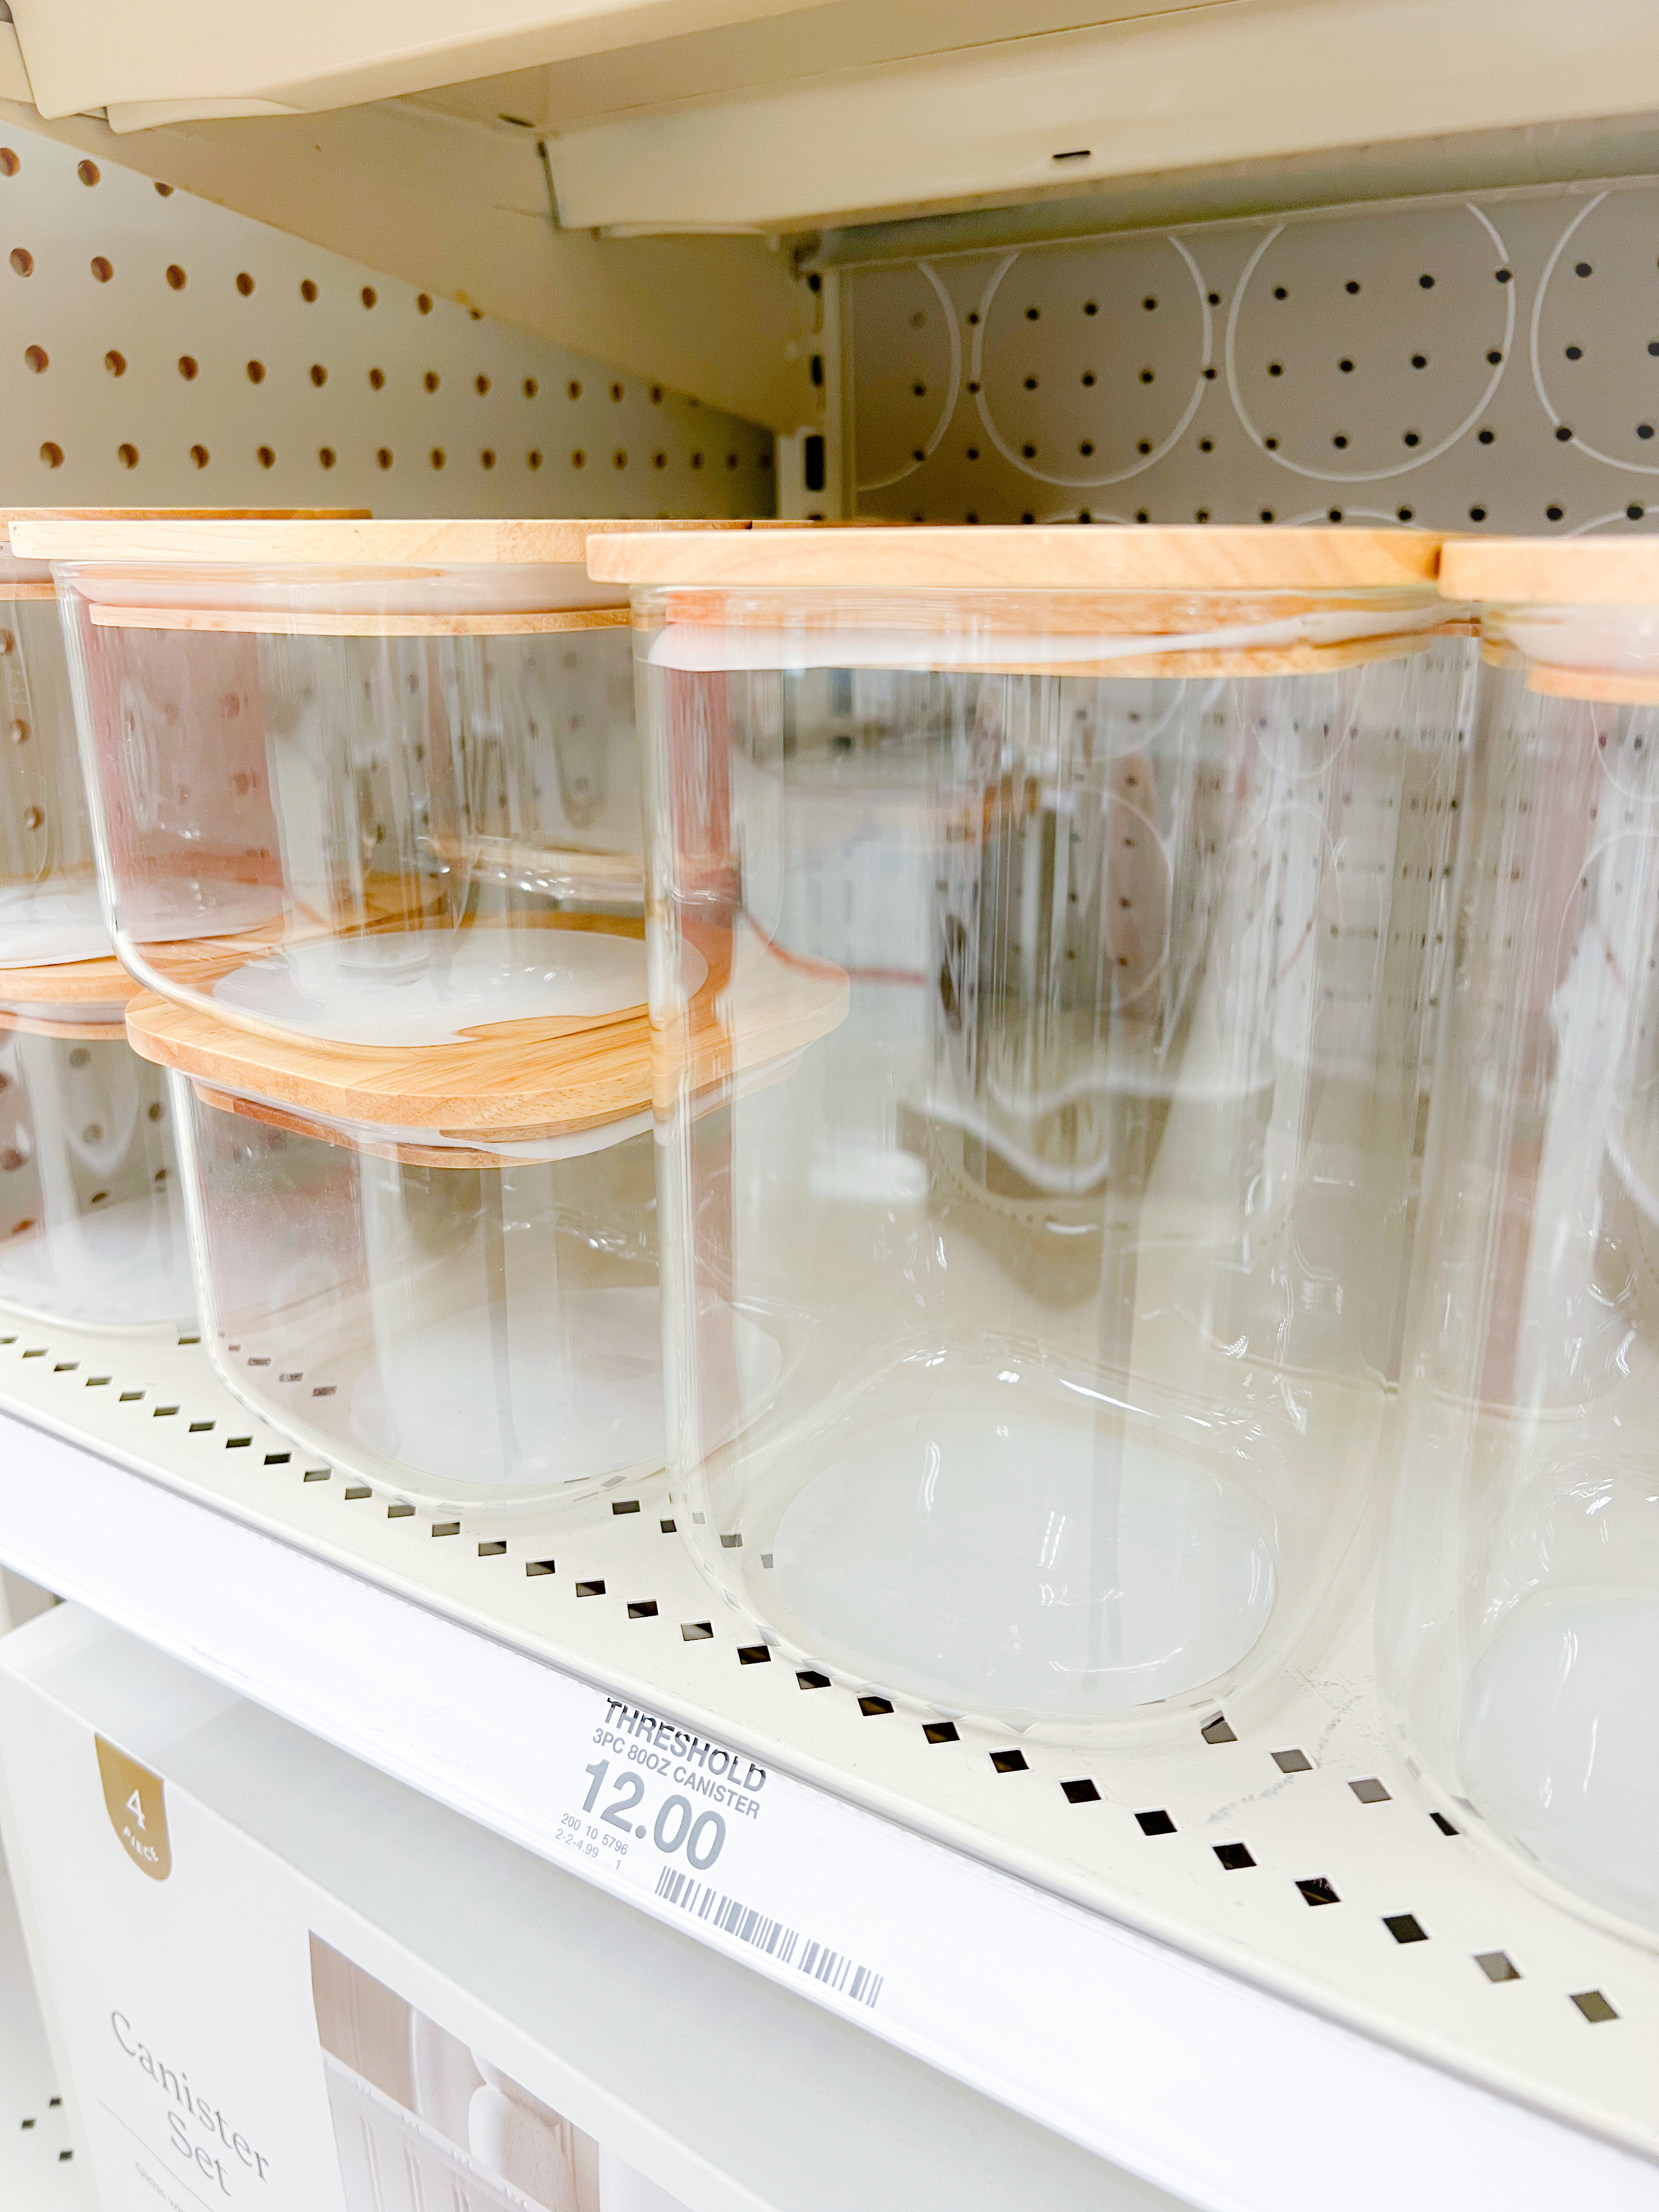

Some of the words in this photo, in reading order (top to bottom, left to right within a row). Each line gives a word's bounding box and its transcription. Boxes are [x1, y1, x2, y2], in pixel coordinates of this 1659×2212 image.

[592, 1728, 625, 1754] 3PC
[628, 1745, 672, 1776] 80OZ
[674, 1766, 760, 1819] CANISTER
[605, 1697, 766, 1792] THRESHOLD
[126, 1789, 146, 1831] 4
[555, 1829, 599, 1858] 2-2-4.99
[616, 1859, 622, 1870] 1
[561, 1813, 581, 1830] 200
[586, 1825, 598, 1839] 10
[602, 1834, 629, 1855] 5796
[582, 1759, 726, 1870] 12.00
[111, 2011, 269, 2183] Canister
[168, 2111, 232, 2197] Set
